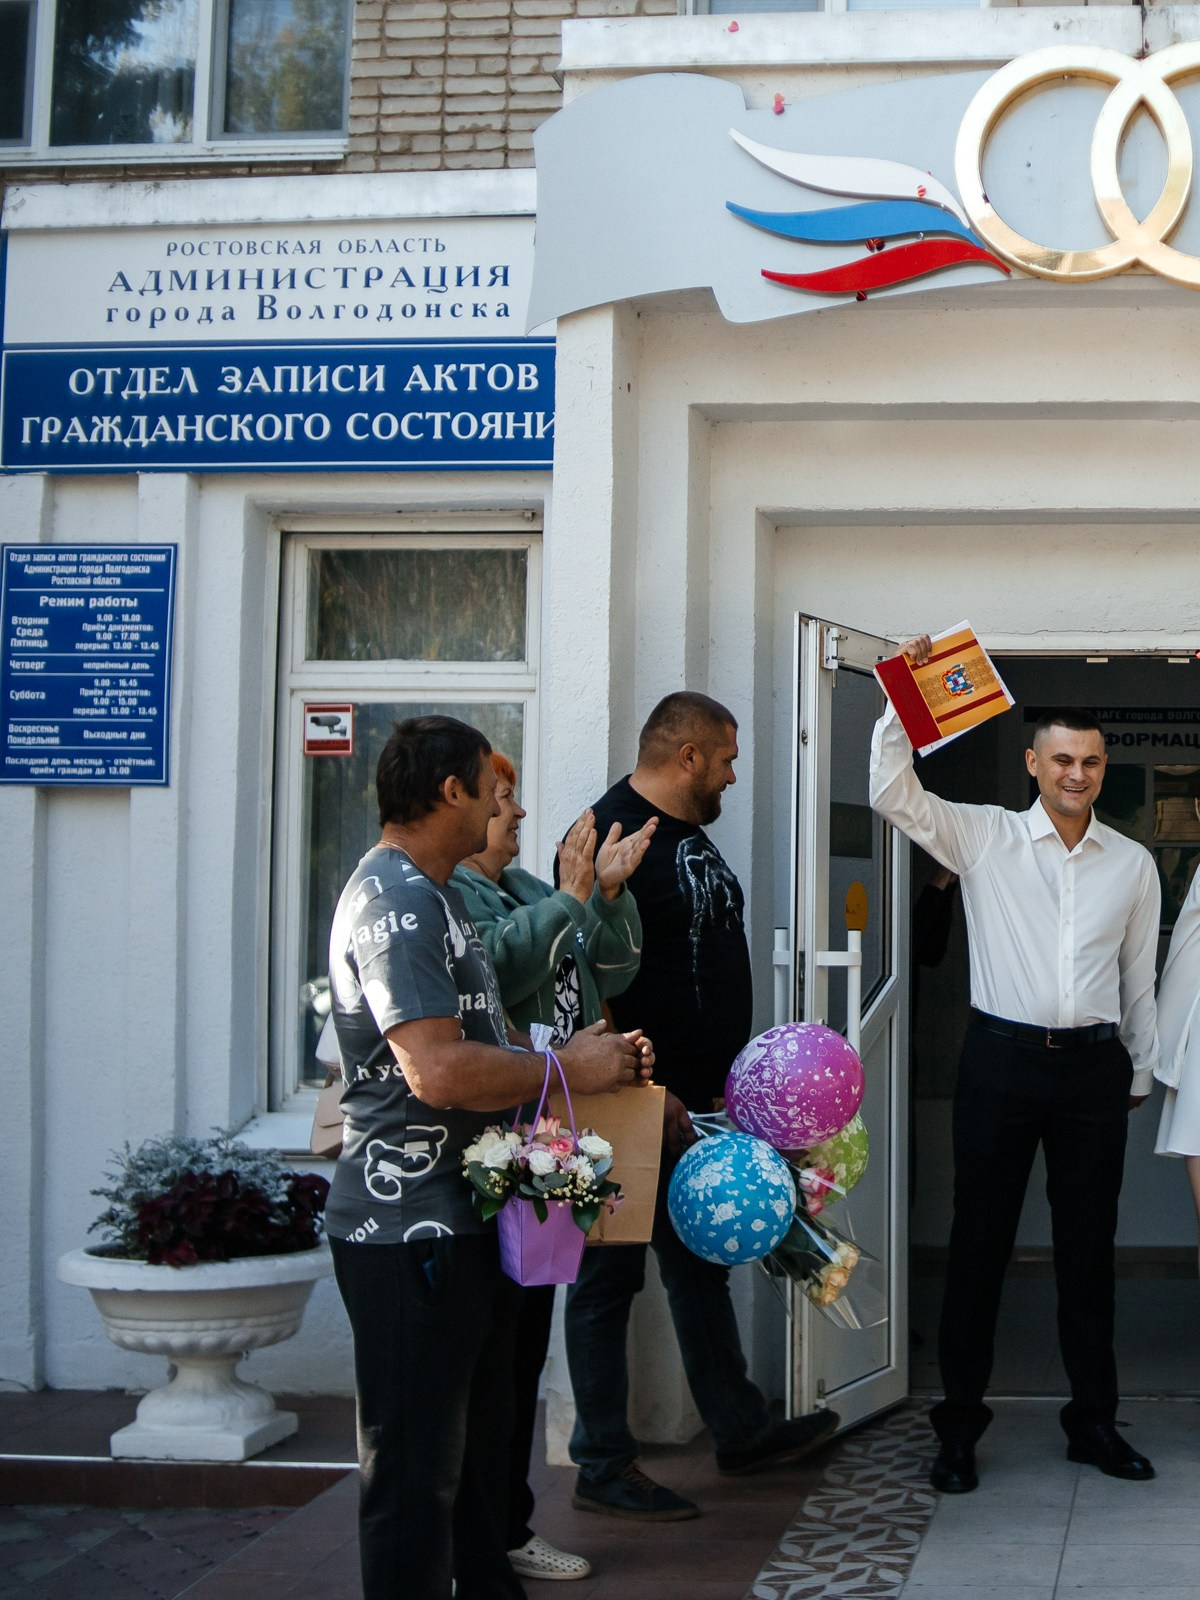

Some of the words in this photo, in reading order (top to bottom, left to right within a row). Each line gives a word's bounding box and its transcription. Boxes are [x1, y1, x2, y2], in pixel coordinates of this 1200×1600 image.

[166, 239, 322, 257] РОСТОВСКАЯ
[338, 238, 446, 255] ОБЛАСТЬ
[108, 265, 511, 294] АДМИНИСТРАЦИЯ
[106, 303, 235, 329] города
[257, 295, 511, 323] Волгодонска
[69, 366, 199, 400] ОТДЕЛ
[218, 364, 385, 394] ЗАПИСИ
[404, 362, 539, 393] АКТОВ
[22, 414, 331, 447] ГРАЖДАНСКОГО
[93, 576, 120, 585] области
[39, 596, 84, 607] Режим
[89, 596, 137, 608] работы
[12, 616, 48, 625] Вторник
[17, 627, 43, 636] Среда
[11, 638, 47, 648] Пятница
[10, 660, 45, 670] Четверг
[10, 690, 45, 700] Суббота
[9, 724, 59, 733] Воскресенье
[8, 735, 59, 745] Понедельник
[84, 730, 127, 739] Выходные
[130, 731, 145, 740] дни
